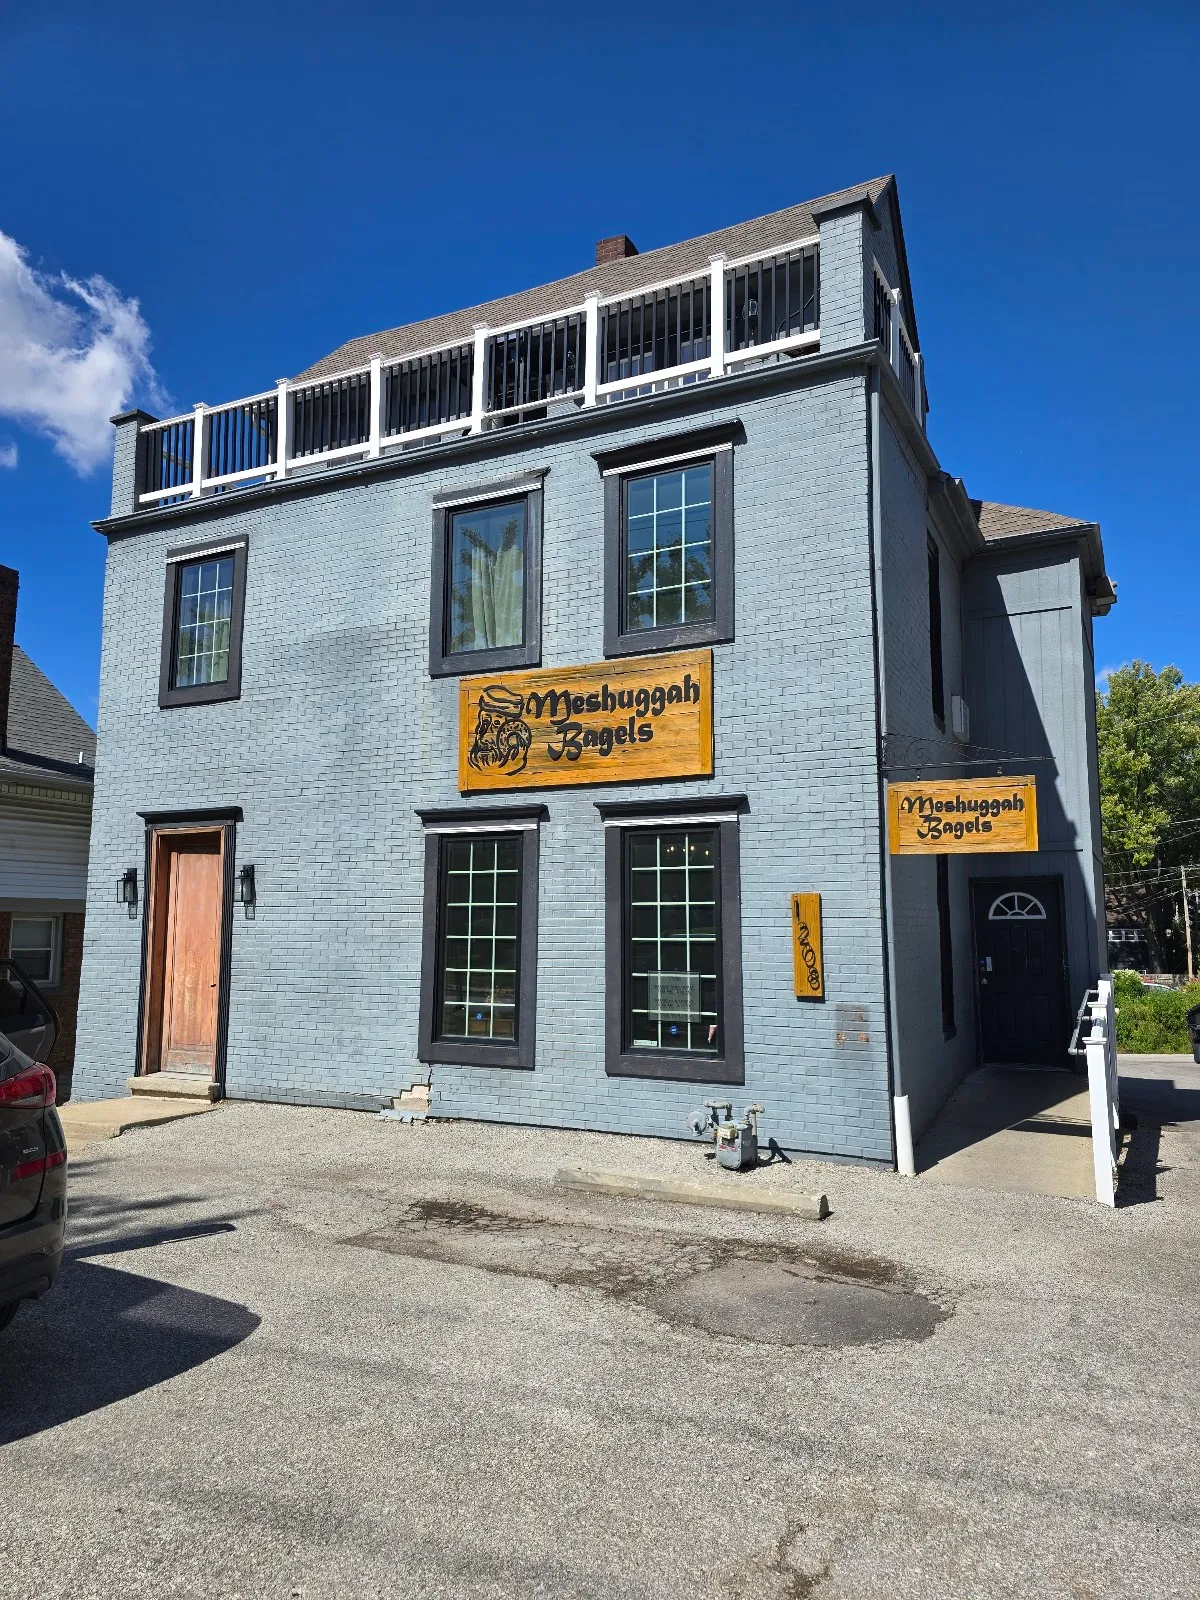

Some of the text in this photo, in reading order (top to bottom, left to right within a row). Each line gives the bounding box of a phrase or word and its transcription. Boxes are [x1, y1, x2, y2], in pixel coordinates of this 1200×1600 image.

[525, 673, 700, 726] Meshuggah
[547, 715, 654, 761] Bagels
[901, 793, 1024, 817] Meshuggah
[917, 815, 992, 839] Bagels
